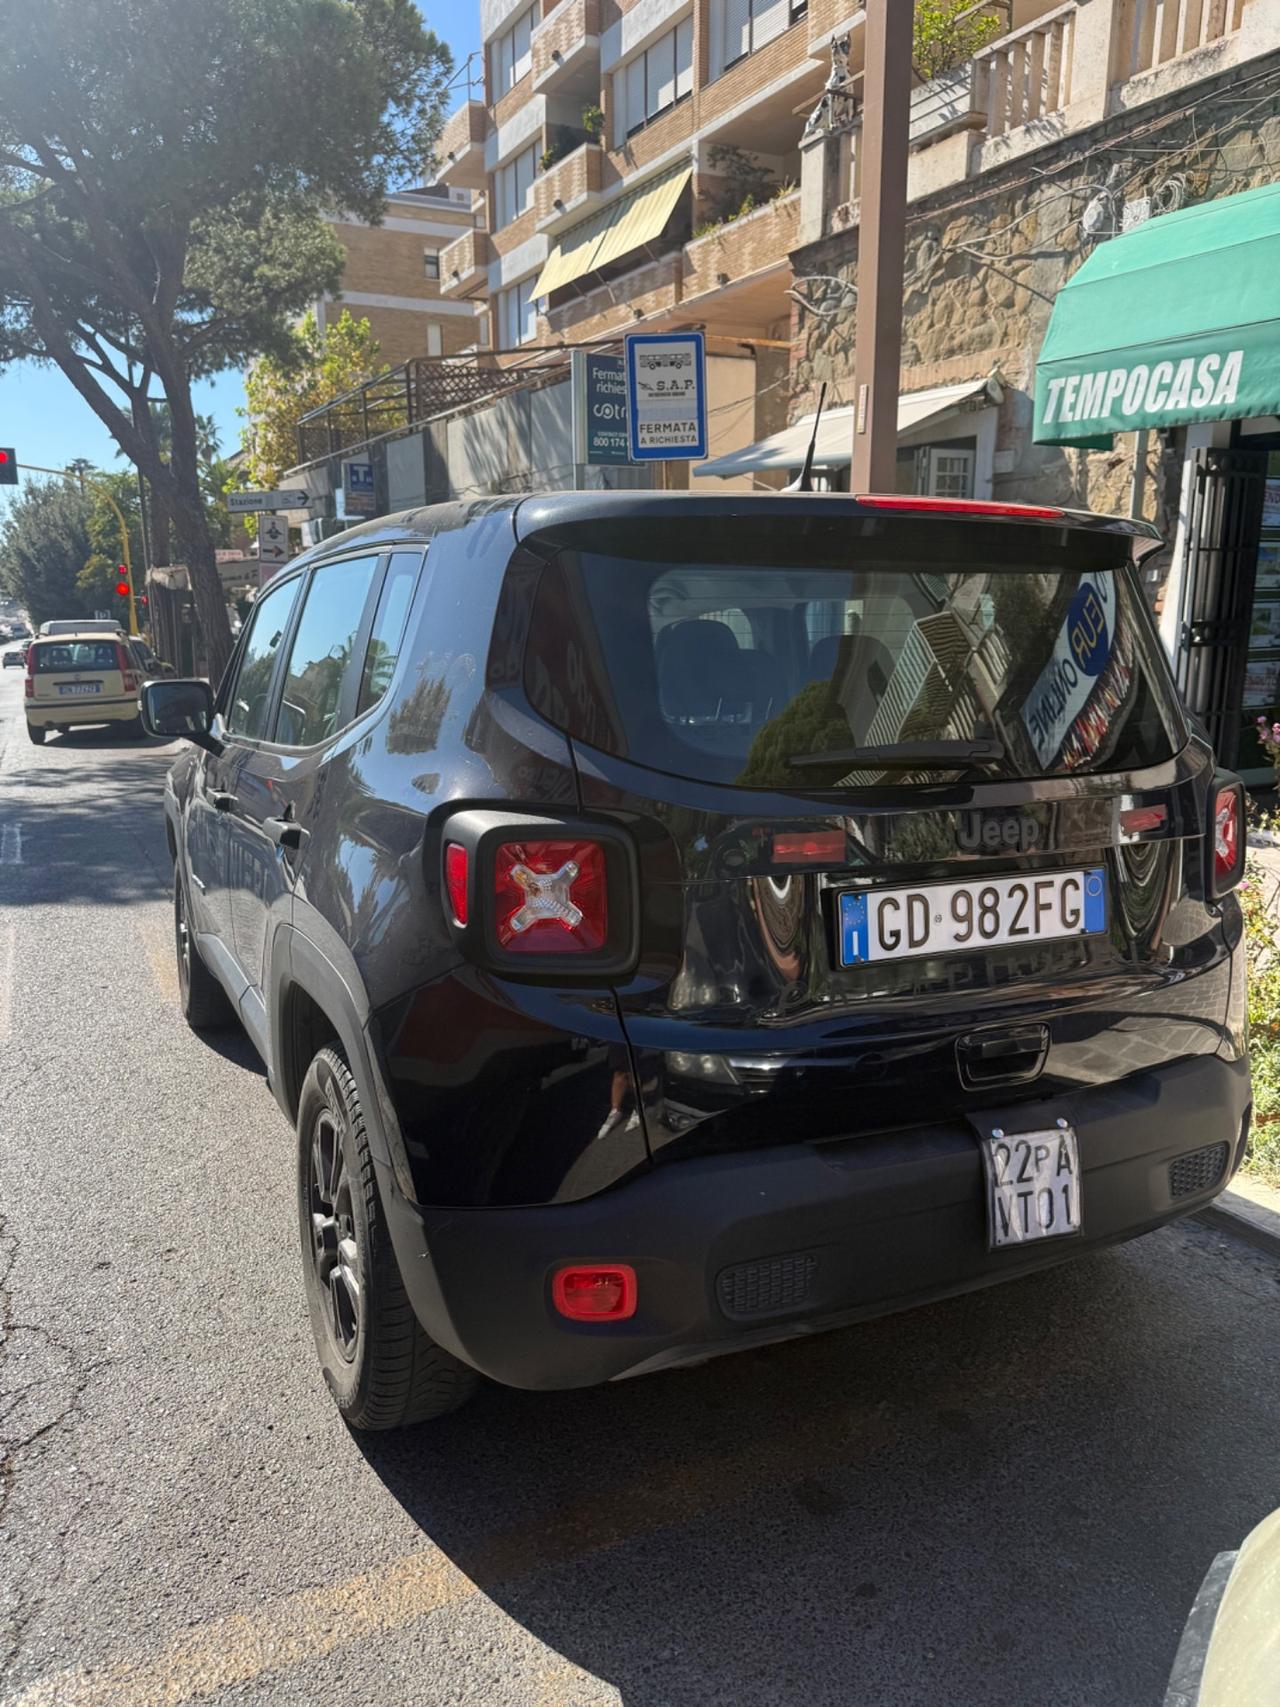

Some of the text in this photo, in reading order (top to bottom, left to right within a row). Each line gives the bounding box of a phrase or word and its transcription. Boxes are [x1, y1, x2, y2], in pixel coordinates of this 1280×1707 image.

[656, 379, 695, 391] S.A.P.
[1042, 350, 1244, 424] TEMPOCASA
[593, 403, 628, 420] cotr
[640, 422, 696, 434] FERMATA
[593, 437, 625, 447] 800 174
[650, 434, 697, 444] RICHIESTA
[230, 498, 263, 506] Stazione
[959, 812, 1040, 851] Jeep
